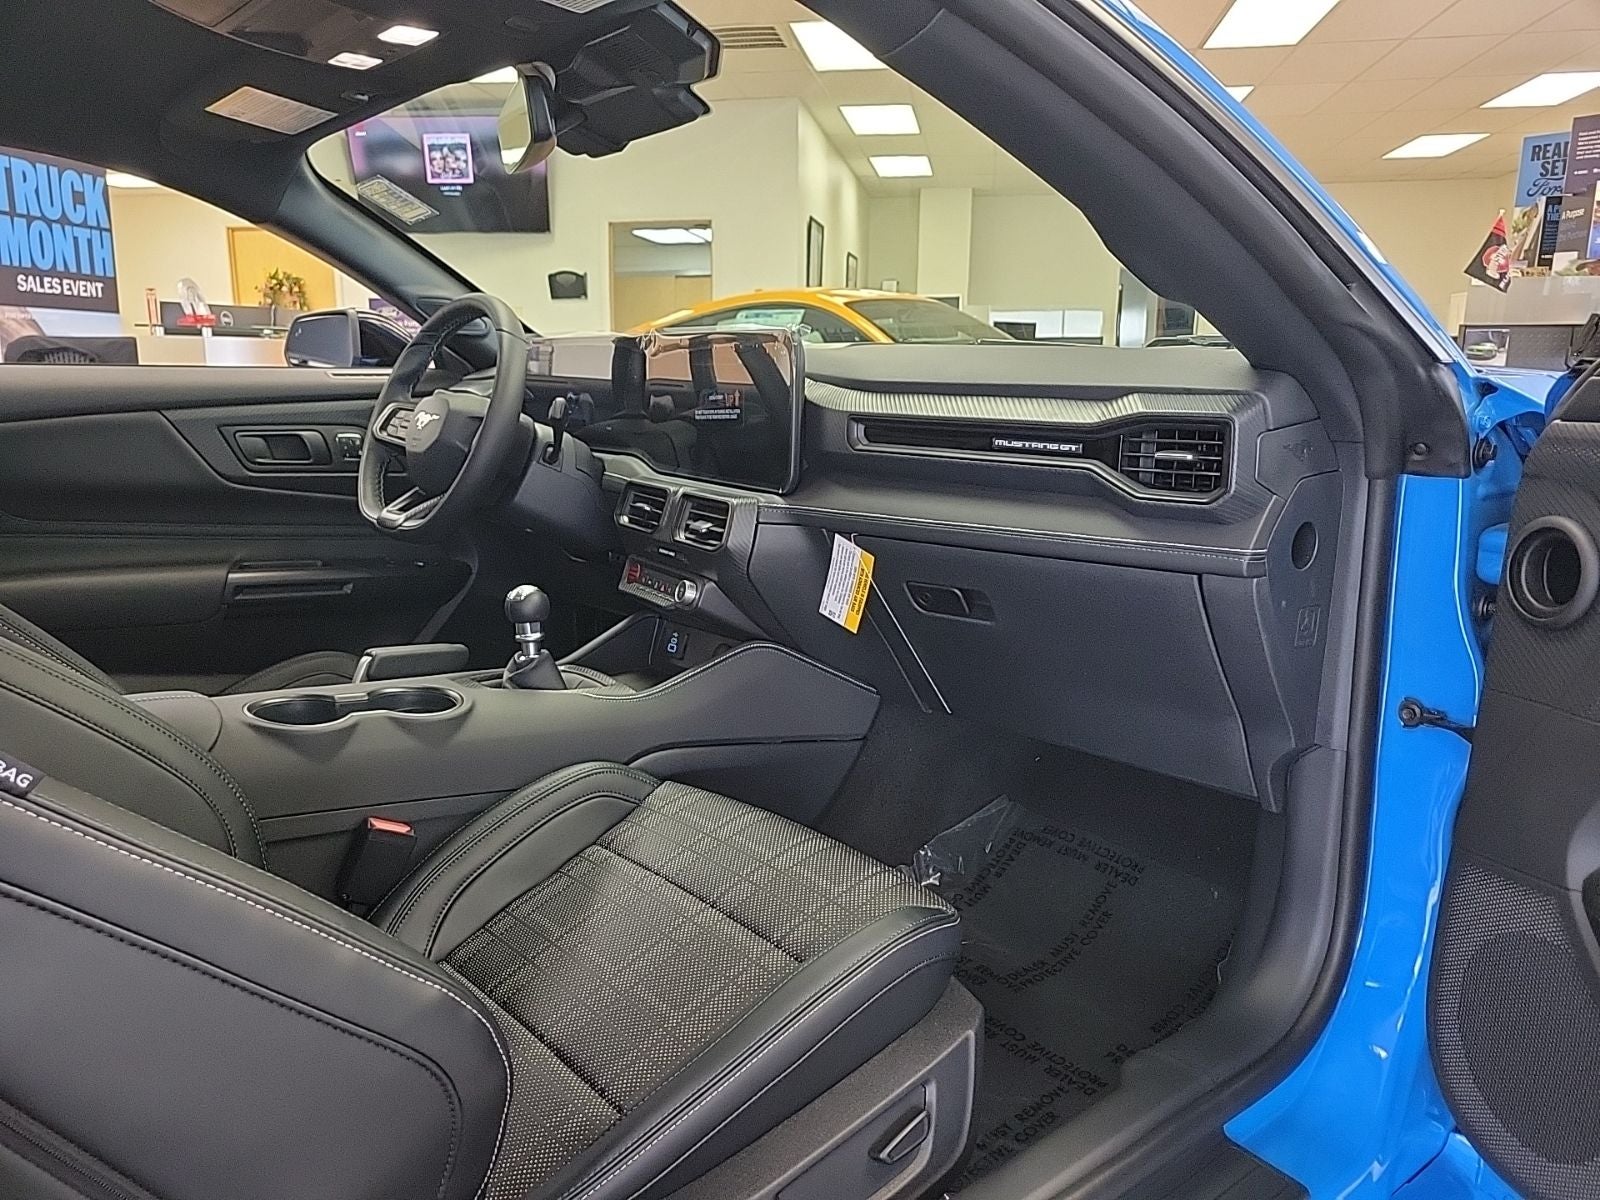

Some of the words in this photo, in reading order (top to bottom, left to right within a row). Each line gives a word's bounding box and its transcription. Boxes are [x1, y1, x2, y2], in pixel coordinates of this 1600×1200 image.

[0, 154, 111, 229] TRUCK
[1527, 177, 1564, 197] For
[0, 214, 115, 278] MONTH
[17, 274, 62, 295] SALES
[62, 278, 104, 298] EVENT
[995, 439, 1059, 450] MUSTANG
[1060, 444, 1079, 452] GT
[1077, 837, 1146, 875] PROTECTIVE
[1094, 860, 1140, 887] DEALER
[1050, 931, 1080, 958] MUST
[1078, 881, 1118, 929] REMOVE
[1019, 948, 1083, 992] PROTECTIVE
[1079, 909, 1114, 947] COVER
[1014, 1083, 1070, 1122] REMOVE
[1014, 1110, 1057, 1144] COVER
